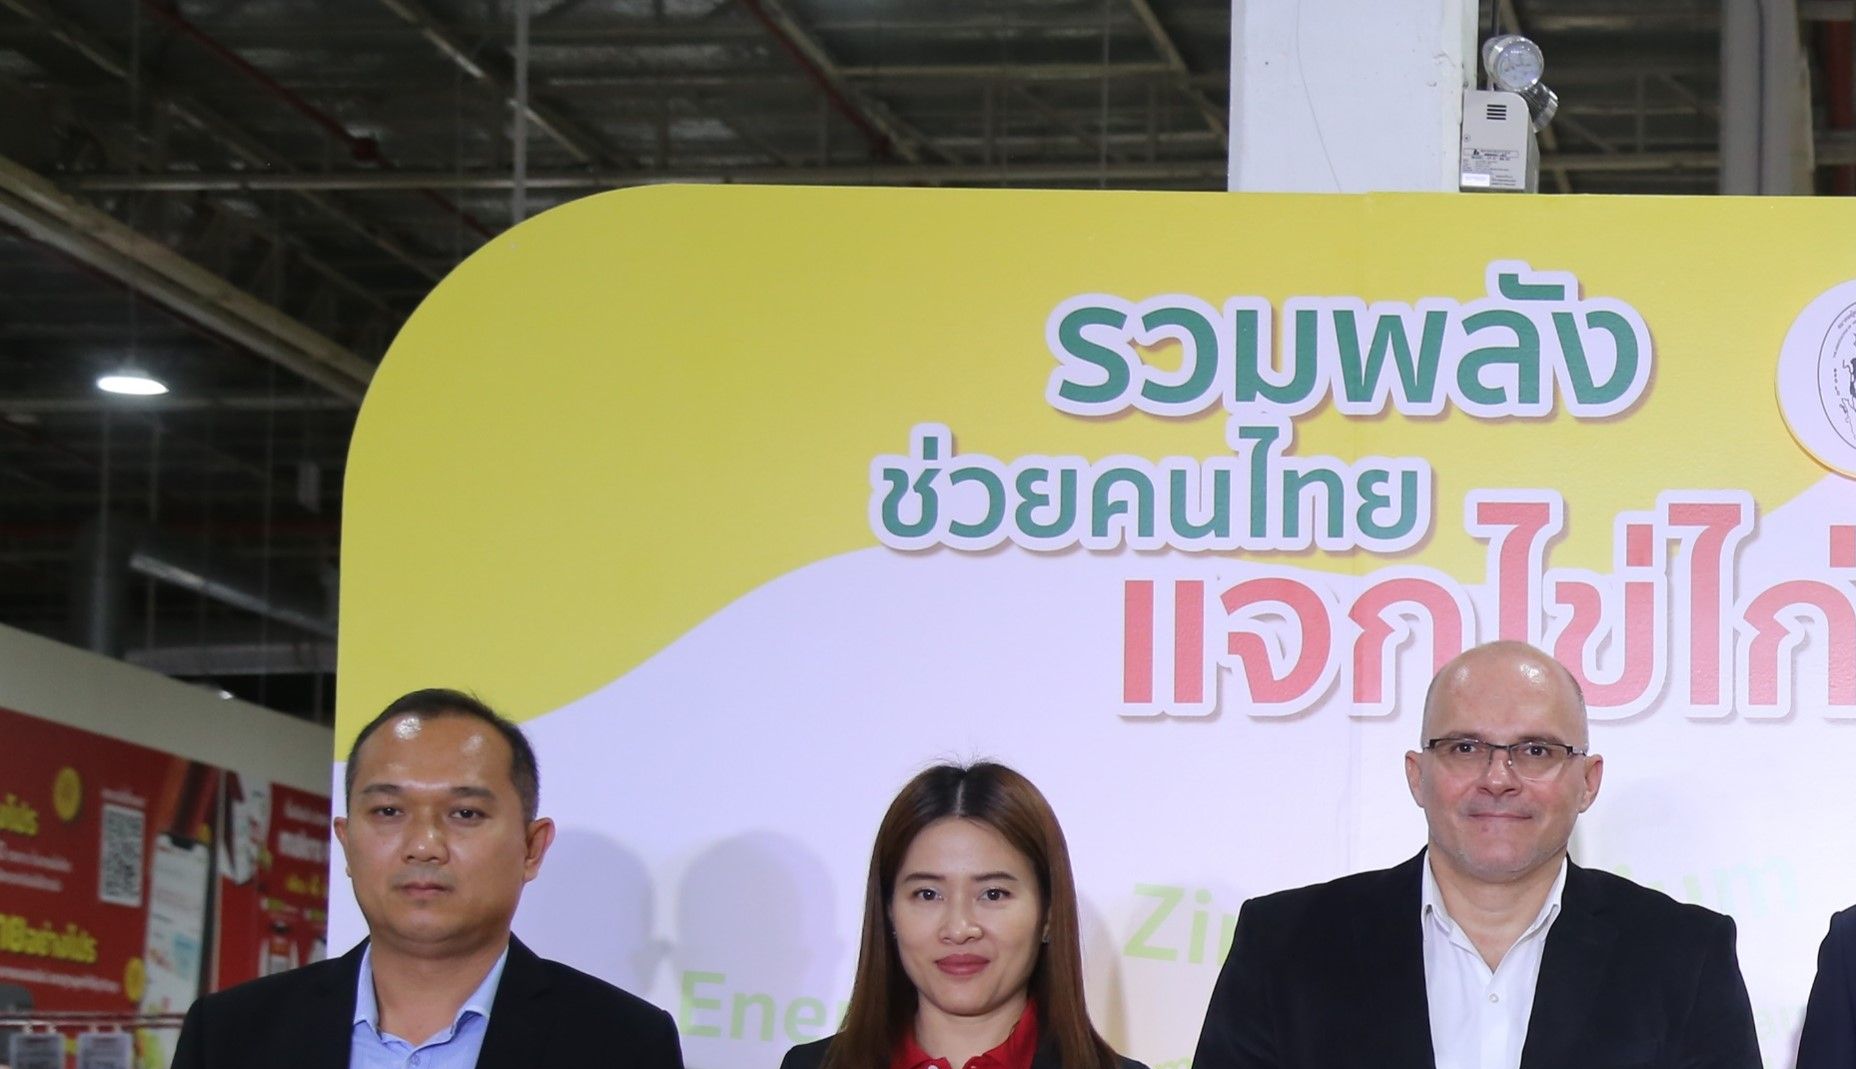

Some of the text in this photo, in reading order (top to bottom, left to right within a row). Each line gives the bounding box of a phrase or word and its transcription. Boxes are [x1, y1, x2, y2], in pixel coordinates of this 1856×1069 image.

[1057, 273, 1639, 405] รวมพลัง
[881, 425, 1418, 539] ช่วยคนไทย
